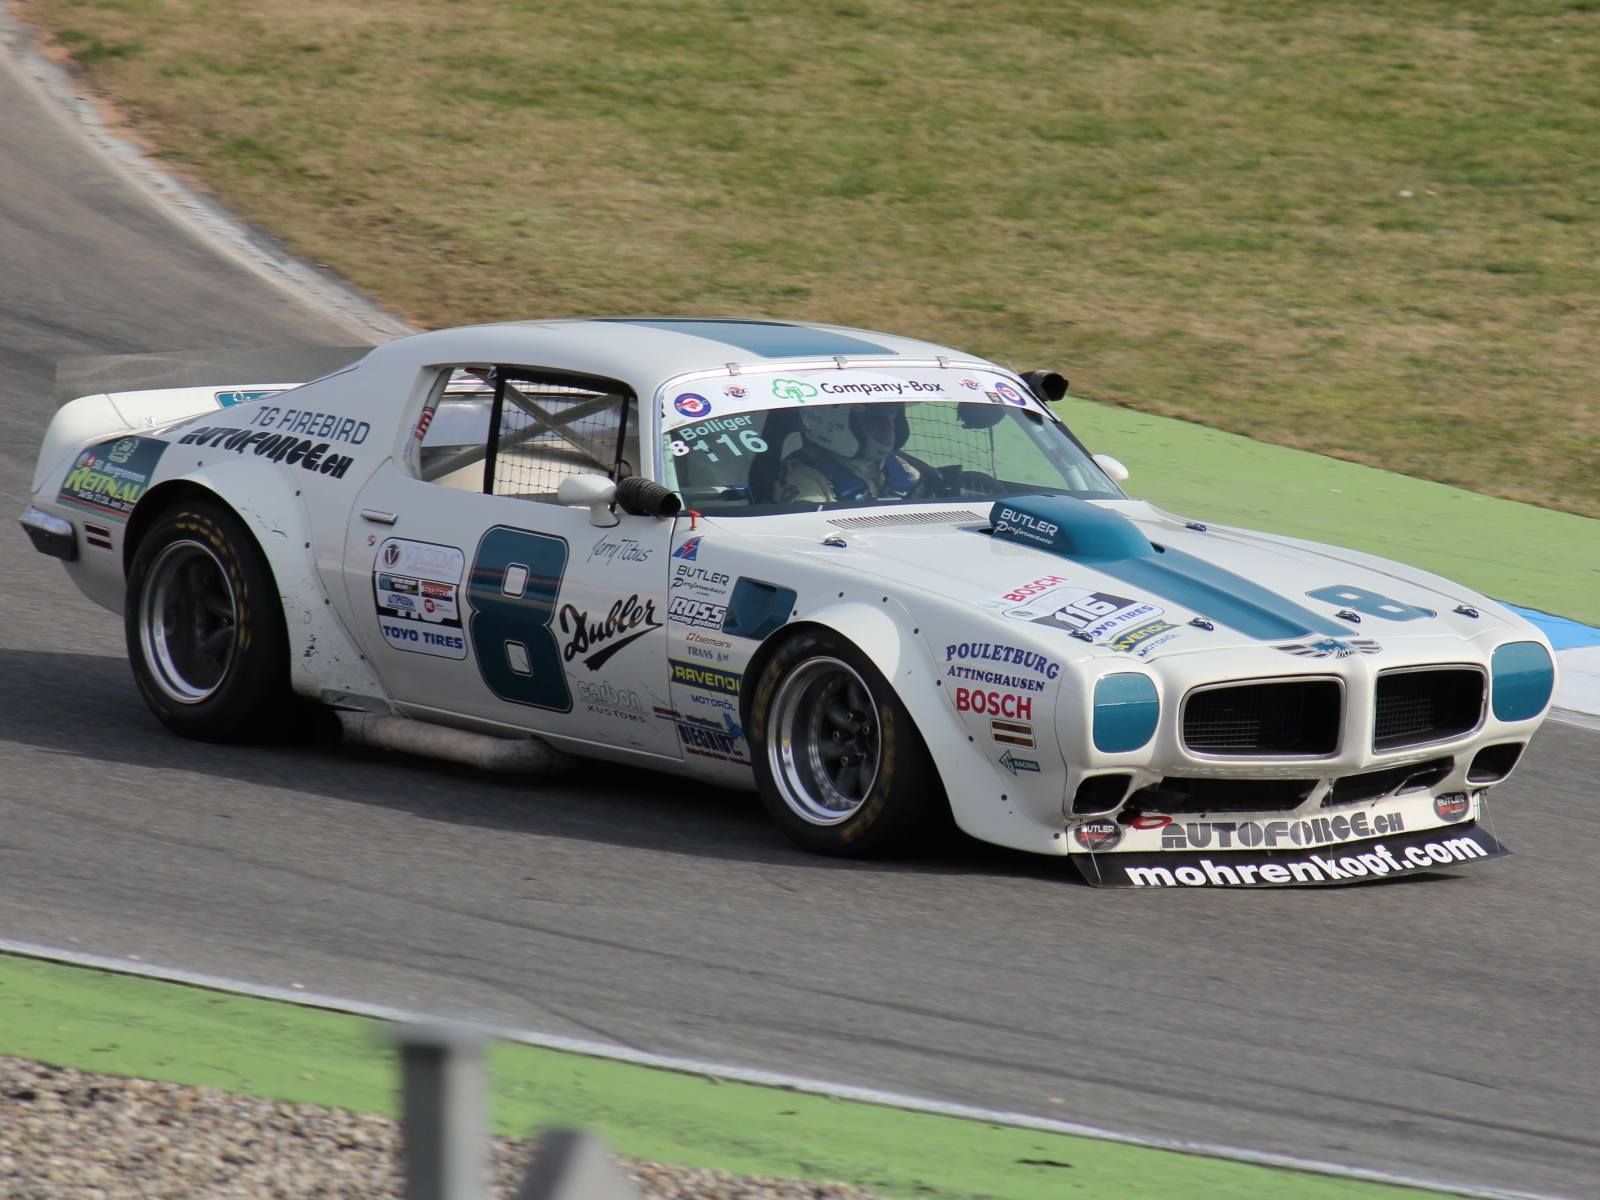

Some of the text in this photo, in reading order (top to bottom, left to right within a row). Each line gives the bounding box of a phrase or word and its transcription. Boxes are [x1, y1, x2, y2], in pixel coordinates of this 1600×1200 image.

[820, 381, 946, 396] Company-Box
[250, 406, 281, 427] TG
[276, 409, 371, 445] FIREBIRD
[679, 415, 752, 441] Bolliger
[669, 429, 768, 462] 8 116
[994, 520, 1054, 545] Performance
[1000, 508, 1058, 537] BUTLER
[587, 534, 653, 566] Jerry Titus
[670, 577, 727, 595] Performance
[676, 565, 730, 586] BUTLER
[1002, 575, 1069, 602] BOSCH
[466, 523, 573, 714] 8
[669, 597, 728, 623] ROSS
[669, 613, 721, 630] racing pistons
[1054, 597, 1118, 630] 116
[1091, 605, 1155, 638] OYO TIRES
[383, 626, 463, 649] TOYO TIRES
[693, 634, 733, 649] bemani
[686, 645, 713, 660] TRANS
[945, 642, 1061, 680] POULETBURG
[947, 665, 1046, 692] ATTINGHAUSEN
[588, 705, 646, 724] KUSTOMS
[691, 694, 736, 712] MOTORÖL
[957, 687, 1033, 720] BOSCH
[1013, 760, 1039, 771] RACING
[1437, 795, 1465, 807] BUTLER
[1124, 836, 1489, 887] mohrenkopf.com
